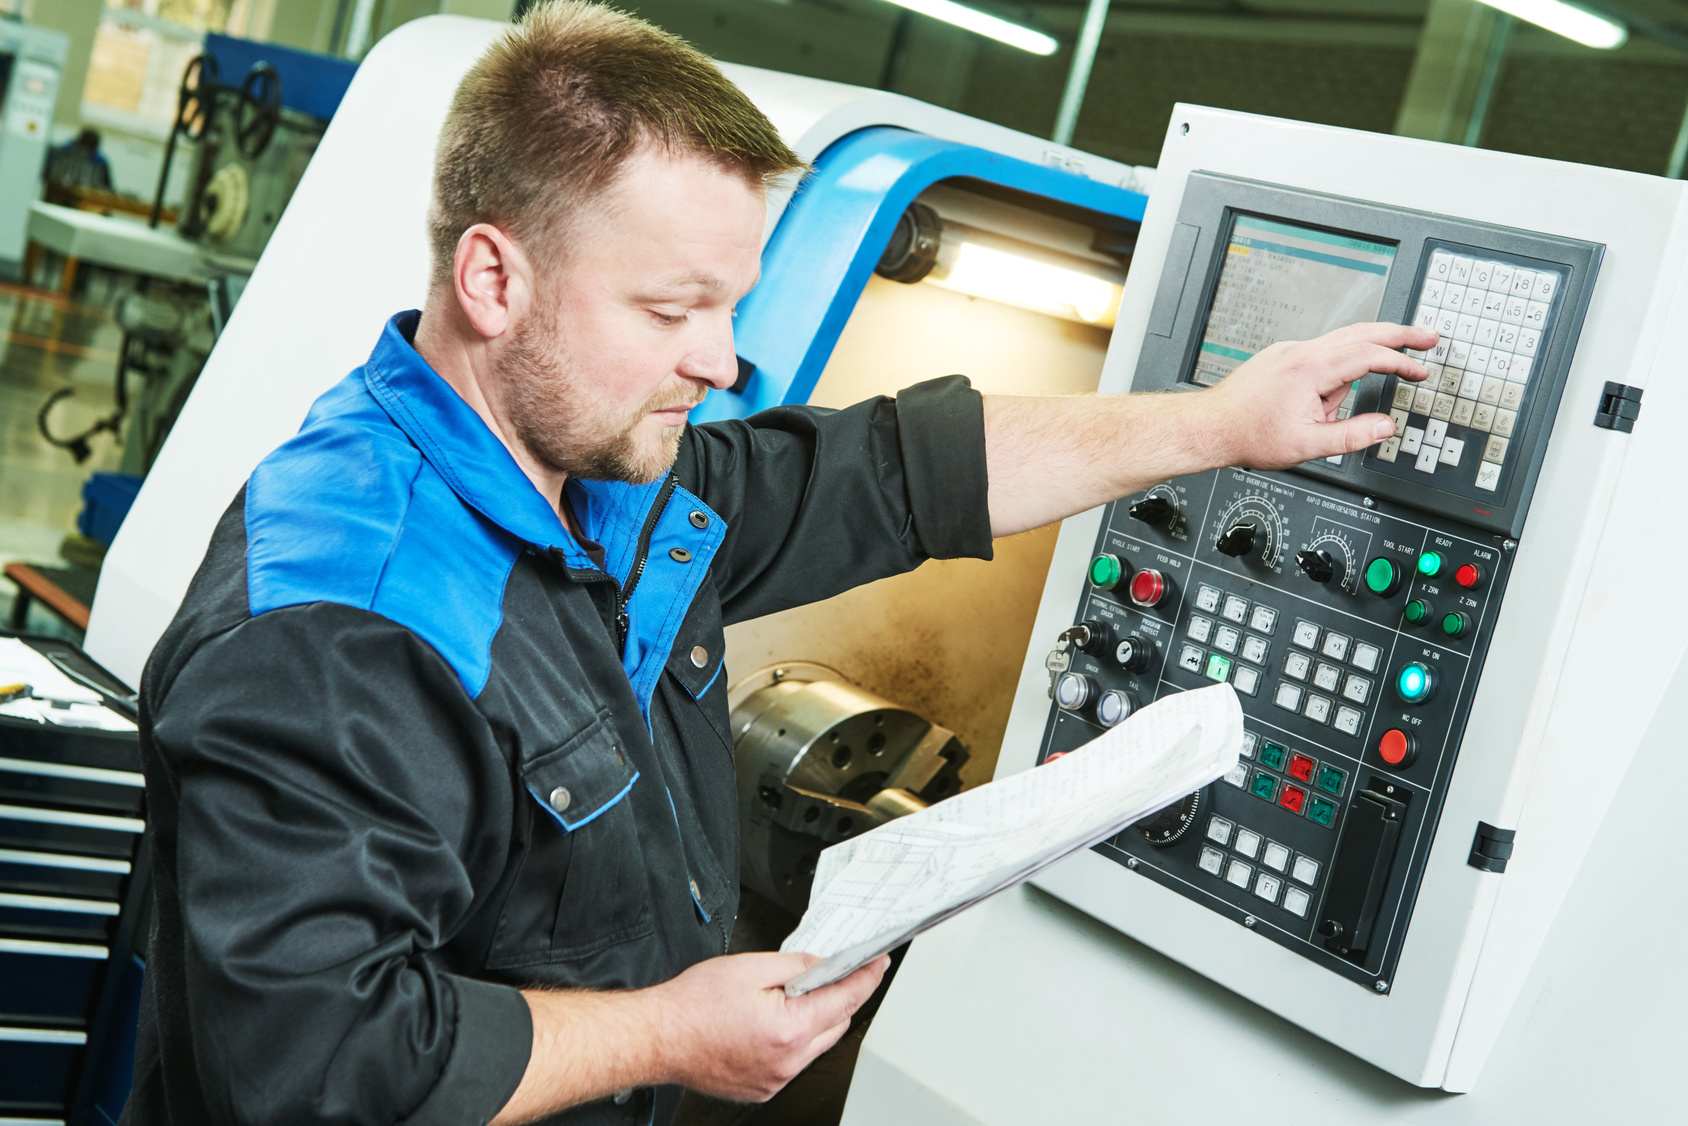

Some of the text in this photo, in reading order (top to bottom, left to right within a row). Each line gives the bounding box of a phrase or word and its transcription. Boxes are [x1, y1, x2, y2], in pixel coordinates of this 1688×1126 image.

[1459, 268, 1467, 278] N
[1478, 272, 1487, 282] G
[1501, 275, 1509, 284] 7
[1521, 279, 1530, 290] 8
[1542, 283, 1550, 294] 9
[1432, 290, 1439, 300] X
[1451, 294, 1459, 304] Z
[1471, 298, 1479, 308] F
[1493, 302, 1501, 312] 4
[1514, 306, 1522, 316] 5
[1534, 310, 1542, 321] 6
[1423, 315, 1432, 326] M
[1444, 320, 1452, 330] S
[1465, 324, 1472, 335] T
[1486, 329, 1492, 338] 1
[1505, 333, 1514, 344] 2
[1526, 338, 1534, 348] 3
[1436, 345, 1446, 356] W
[1232, 473, 1244, 482] FEED
[1246, 477, 1268, 489] OVERRIDE
[1306, 496, 1321, 506] RAPID
[1360, 512, 1381, 524] STATION
[1474, 508, 1492, 517] FANUC
[1112, 538, 1140, 553] CYCLE START
[1383, 540, 1414, 555] TOOL START
[1435, 537, 1453, 548] READY
[1473, 549, 1492, 560] ALARM
[1157, 554, 1181, 568] FEED HOLD
[1428, 587, 1439, 596] ZRN
[1466, 598, 1477, 608] ZRN
[1101, 610, 1114, 619] CHUCK
[1142, 618, 1161, 629] PROGRAM
[1140, 624, 1159, 636] PROTECT
[1304, 632, 1312, 640] +C
[1333, 643, 1342, 652] +X
[1422, 648, 1441, 660] NC ON
[1086, 663, 1099, 673] CHUCK
[1296, 662, 1305, 671] -Z
[1129, 681, 1139, 691] TAIL
[1354, 685, 1364, 694] +Z
[1315, 704, 1324, 713] -X
[1346, 718, 1354, 726] -C
[1402, 714, 1422, 726] NC OFF
[1264, 882, 1273, 893] F1
